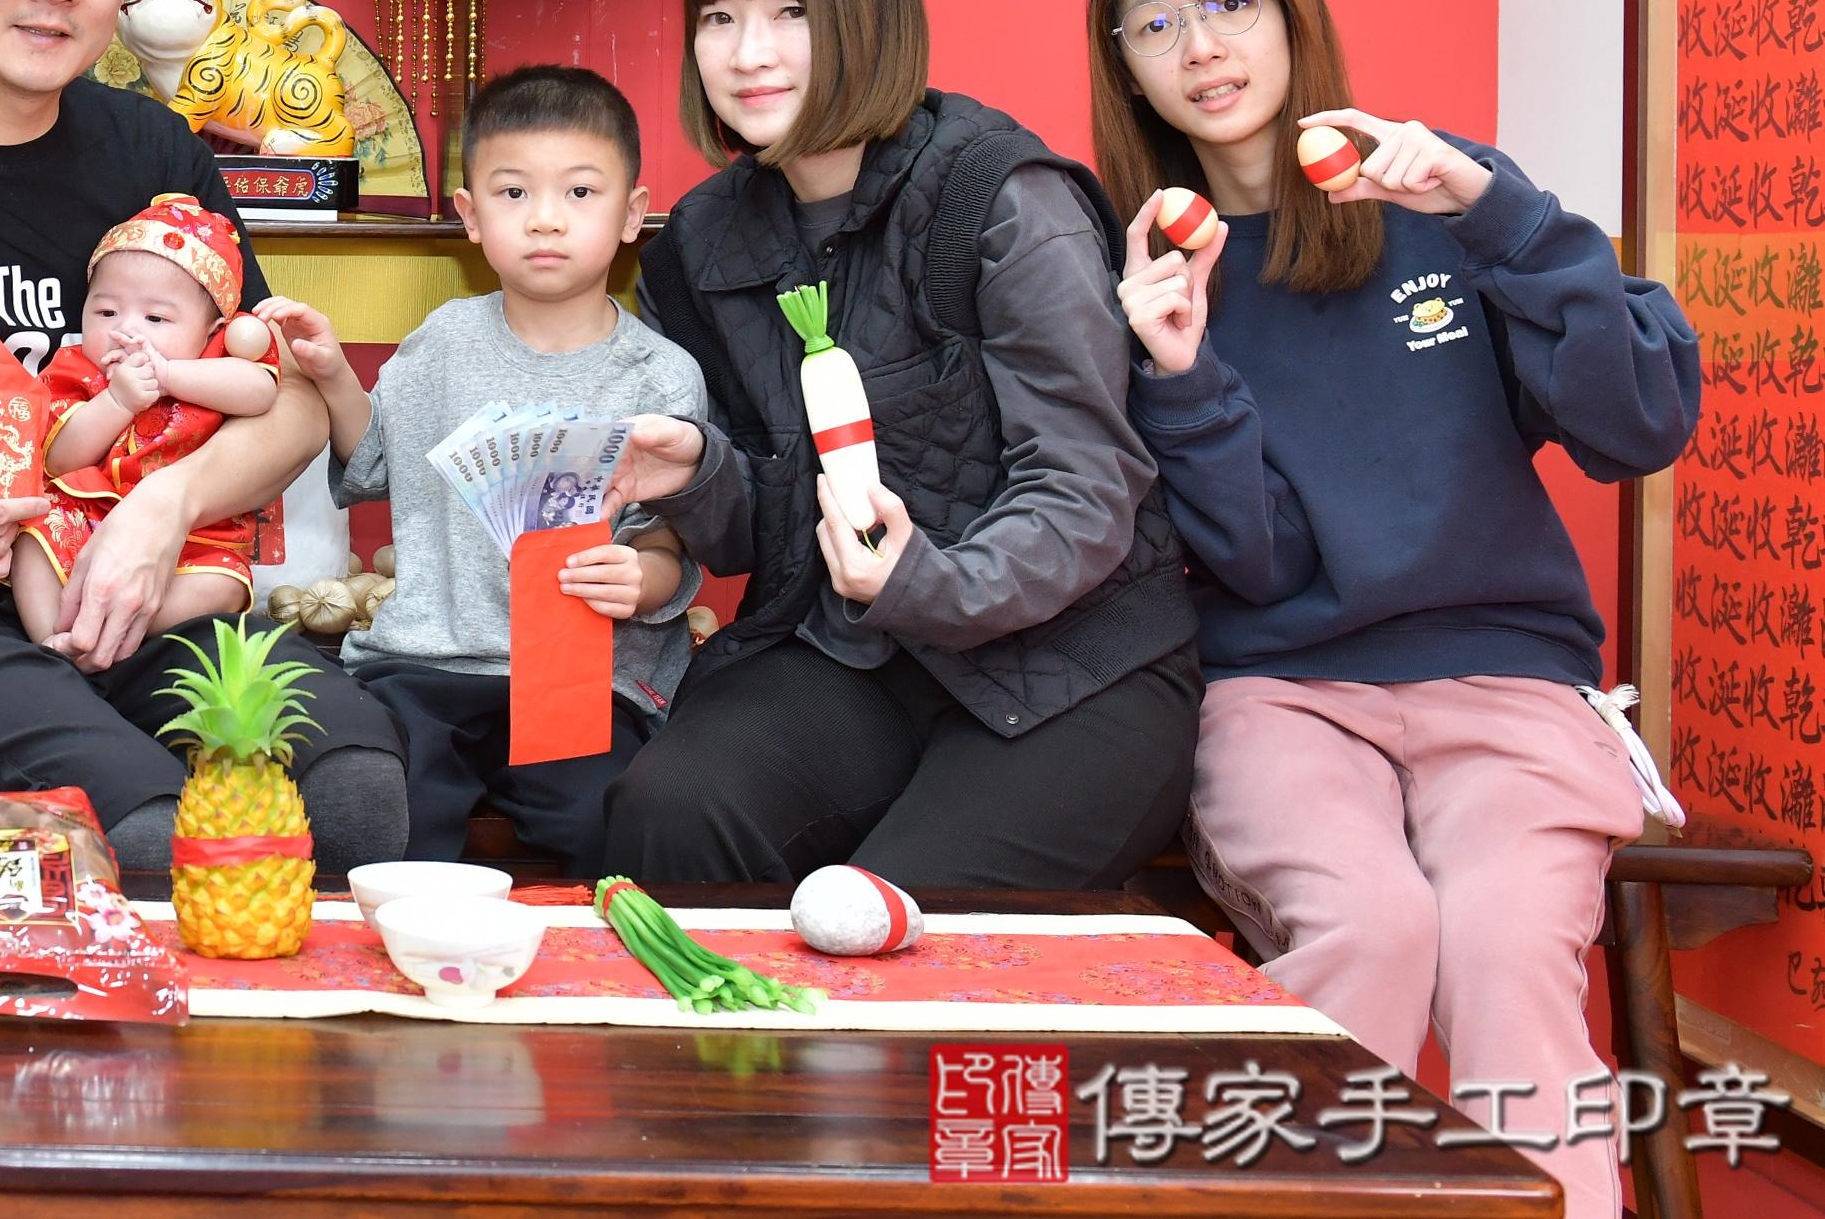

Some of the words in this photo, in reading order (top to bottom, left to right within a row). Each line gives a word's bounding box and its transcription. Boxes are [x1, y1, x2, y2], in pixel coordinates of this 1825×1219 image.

[1390, 273, 1452, 304] ENJOY
[1693, 323, 1824, 398] 涎收乾
[486, 437, 501, 467] 1000
[509, 432, 520, 461] 1000
[530, 432, 543, 458] 1000
[550, 428, 568, 453] 1000
[599, 427, 627, 463] 1000
[449, 451, 473, 482] 1000
[469, 446, 486, 476] 1000
